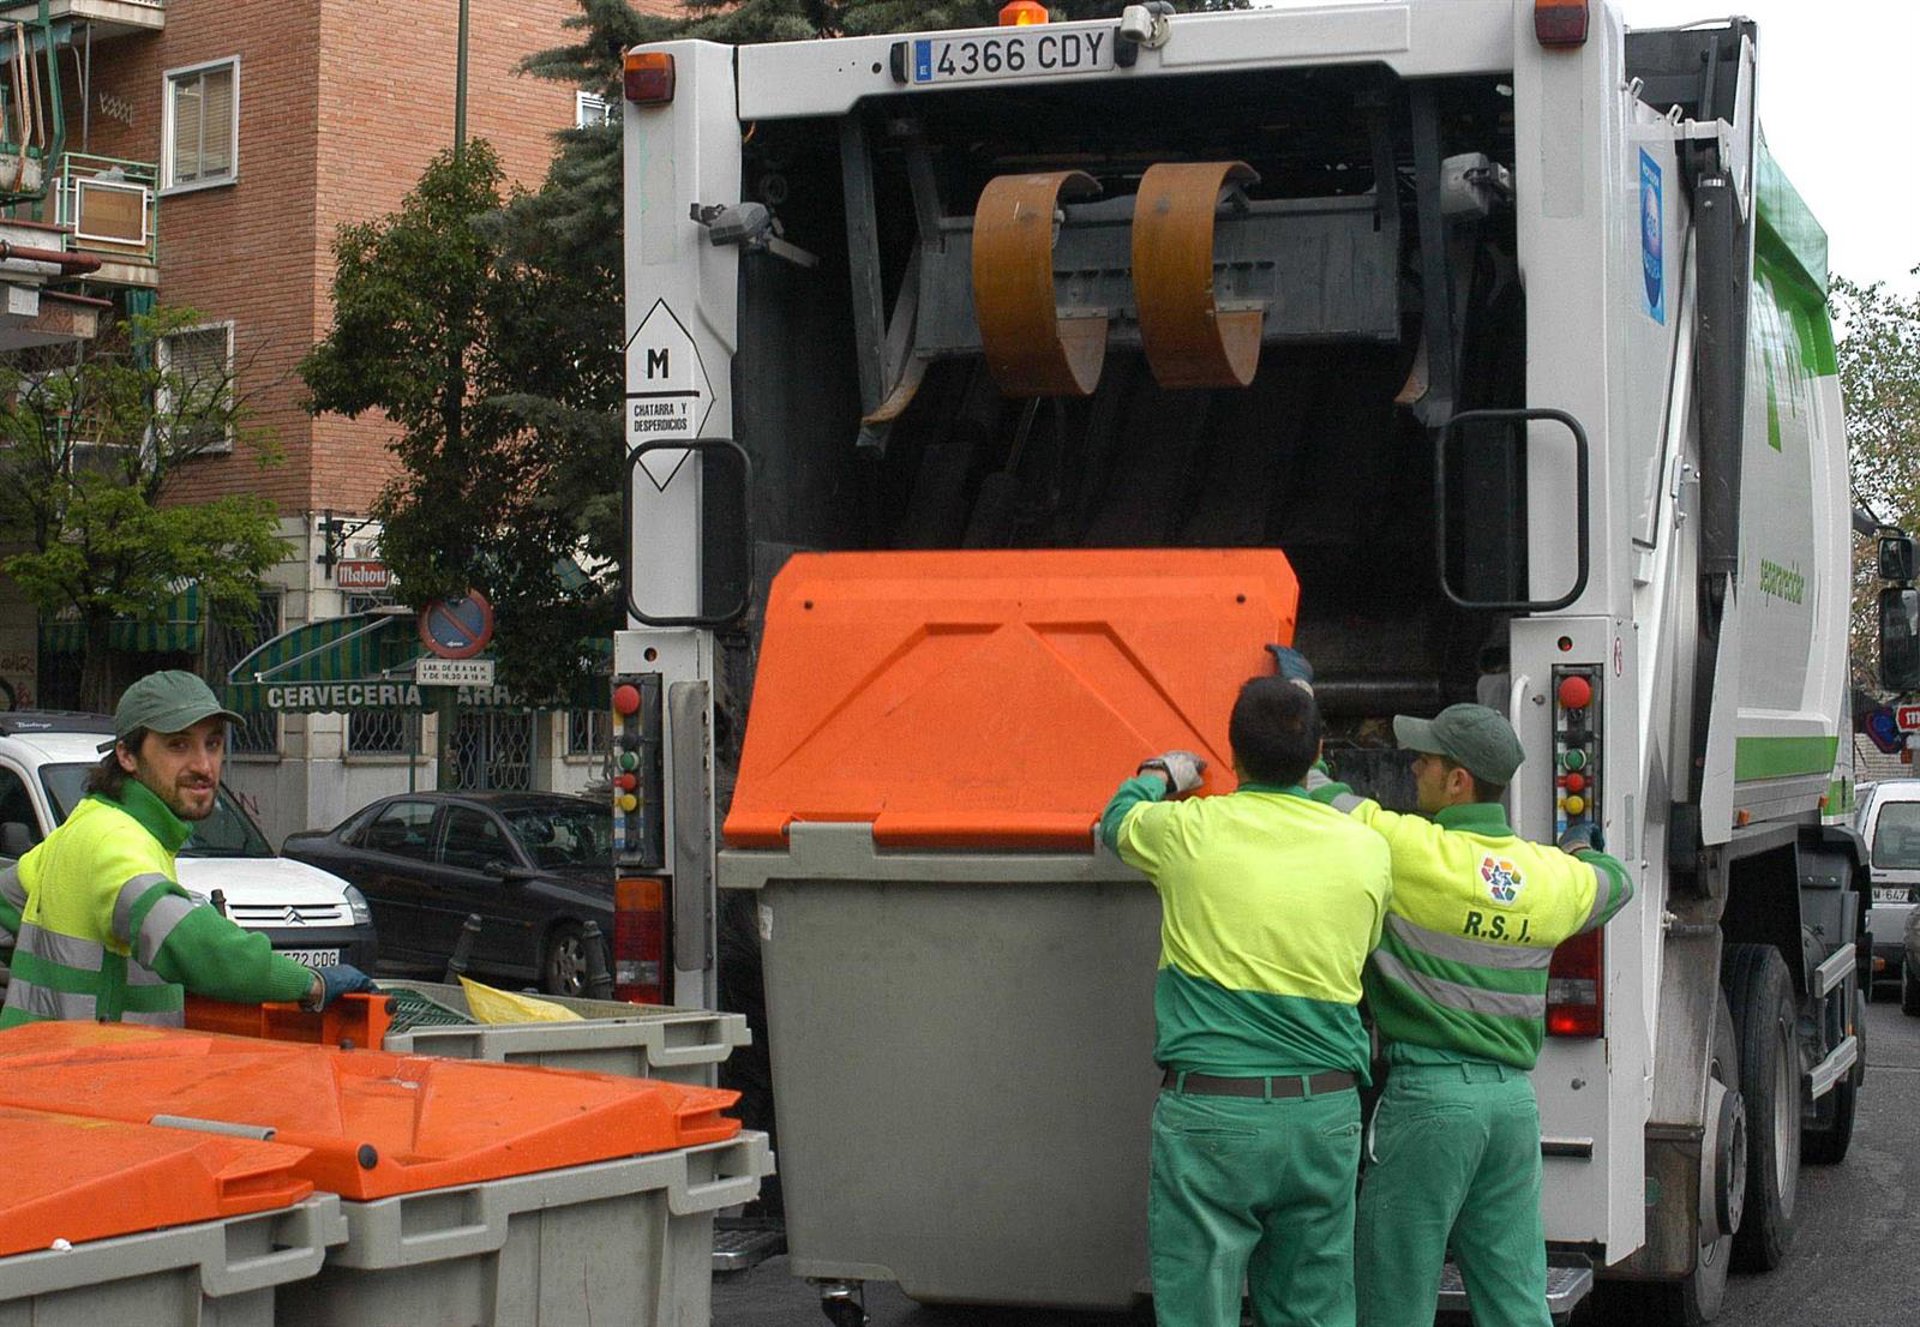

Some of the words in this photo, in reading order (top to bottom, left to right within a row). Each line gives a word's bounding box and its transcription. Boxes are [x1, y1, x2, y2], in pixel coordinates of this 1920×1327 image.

[936, 38, 1026, 76] 4366
[1037, 31, 1105, 68] CDY
[647, 348, 669, 380] M
[634, 403, 674, 416] CHATARRA
[681, 402, 687, 415] Y
[634, 418, 687, 432] DESPERDICIOS
[339, 564, 386, 584] Mahou
[442, 664, 452, 672] DE
[267, 684, 422, 708] CERVECERIA
[313, 952, 336, 967] CDG
